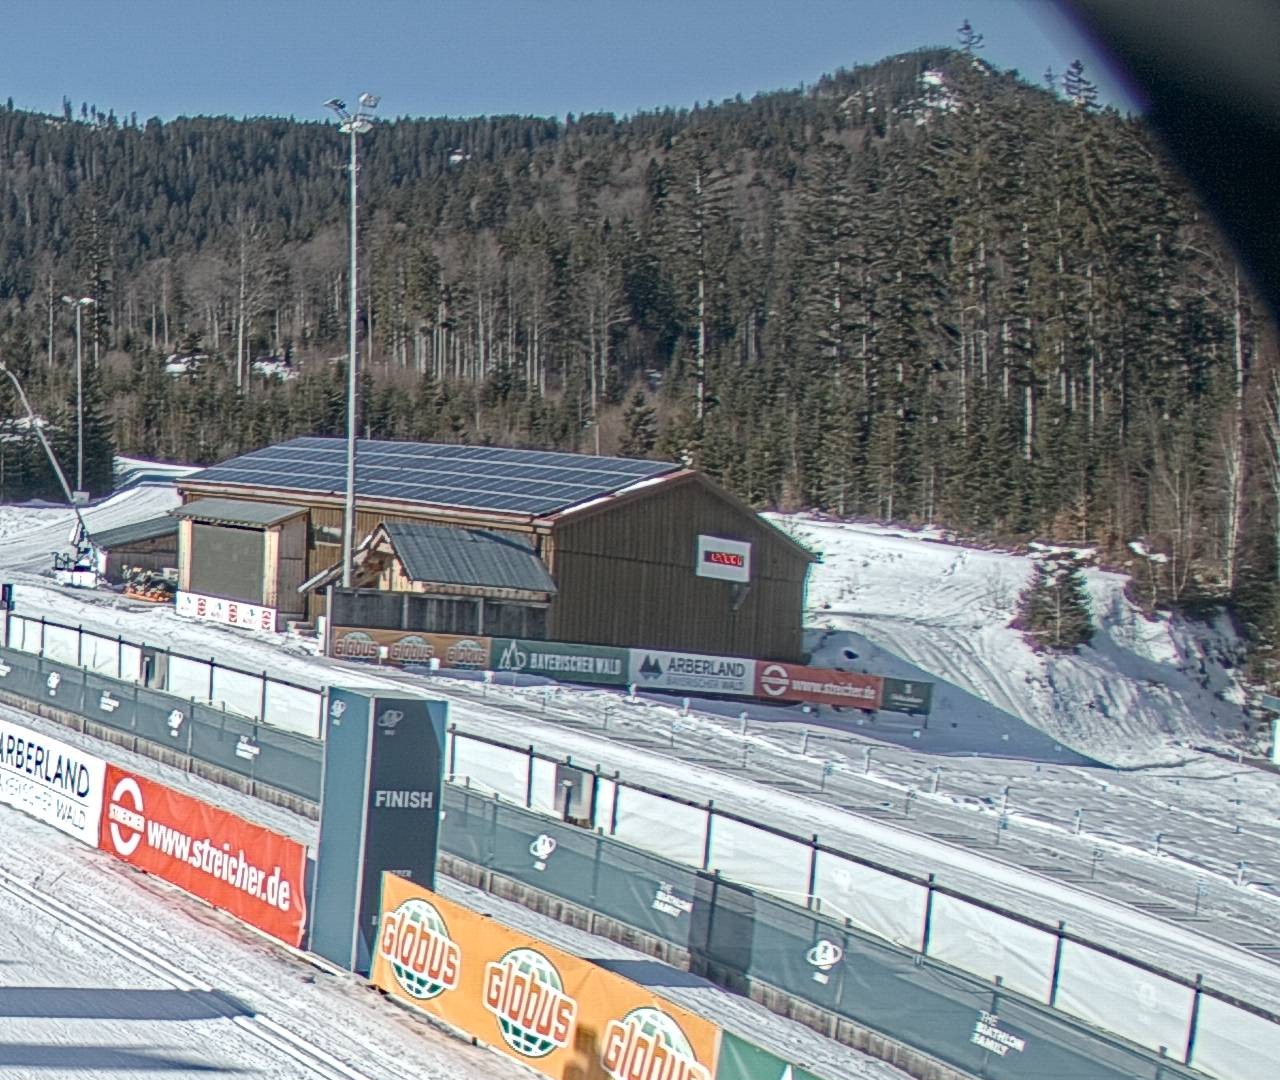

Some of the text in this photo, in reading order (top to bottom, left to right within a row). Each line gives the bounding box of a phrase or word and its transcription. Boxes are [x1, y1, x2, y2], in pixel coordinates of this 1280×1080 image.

[530, 653, 621, 676] BAYERISCHER WALD
[668, 656, 746, 678] ARBERLAND
[375, 790, 434, 809] FINISH
[56, 799, 86, 830] WALD
[147, 820, 290, 912] www.streicher.de
